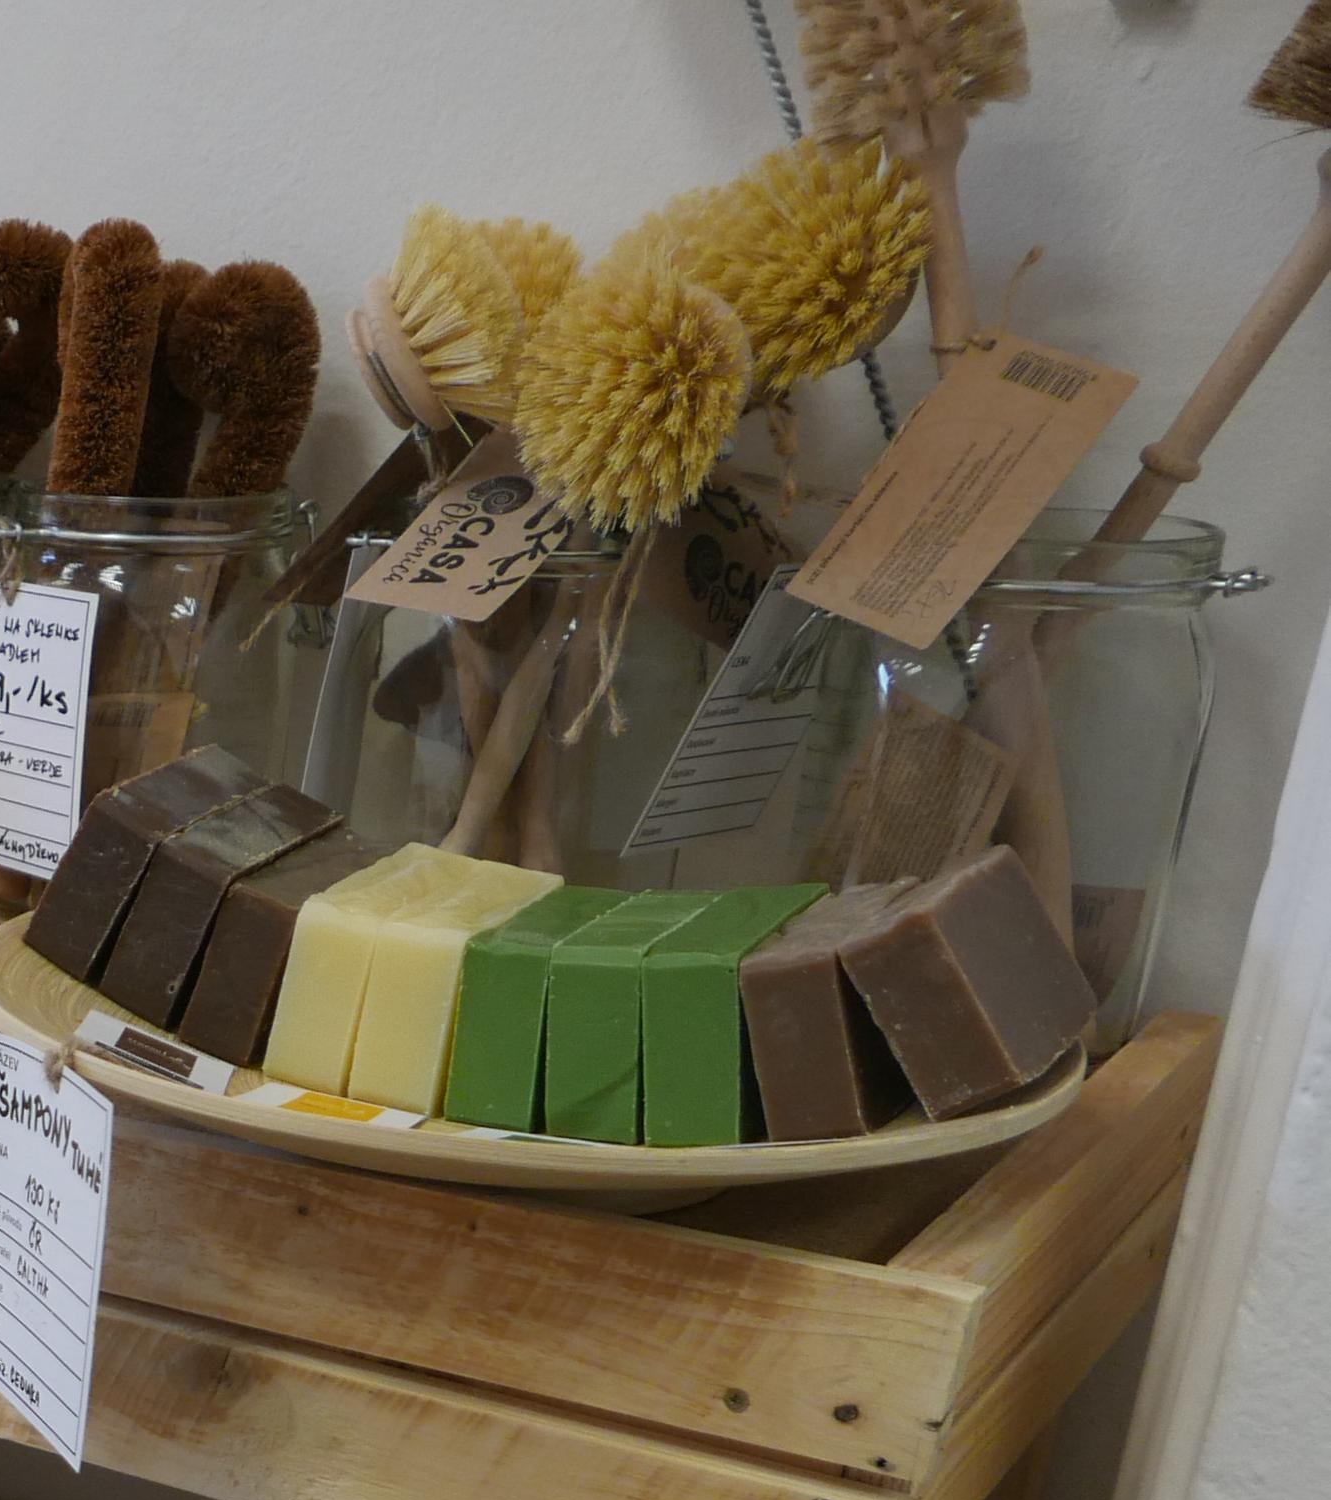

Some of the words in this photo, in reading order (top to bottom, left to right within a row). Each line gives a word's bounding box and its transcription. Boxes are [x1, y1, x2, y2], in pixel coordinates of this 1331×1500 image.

[382, 503, 477, 585] Organica
[408, 516, 495, 584] CASA
[4, 615, 21, 635] NA
[71, 1140, 102, 1194] TUHÉ
[24, 1174, 44, 1207] 130
[1, 1210, 22, 1231] původu
[28, 1218, 43, 1256] ČR
[16, 1254, 49, 1299] CALTHA
